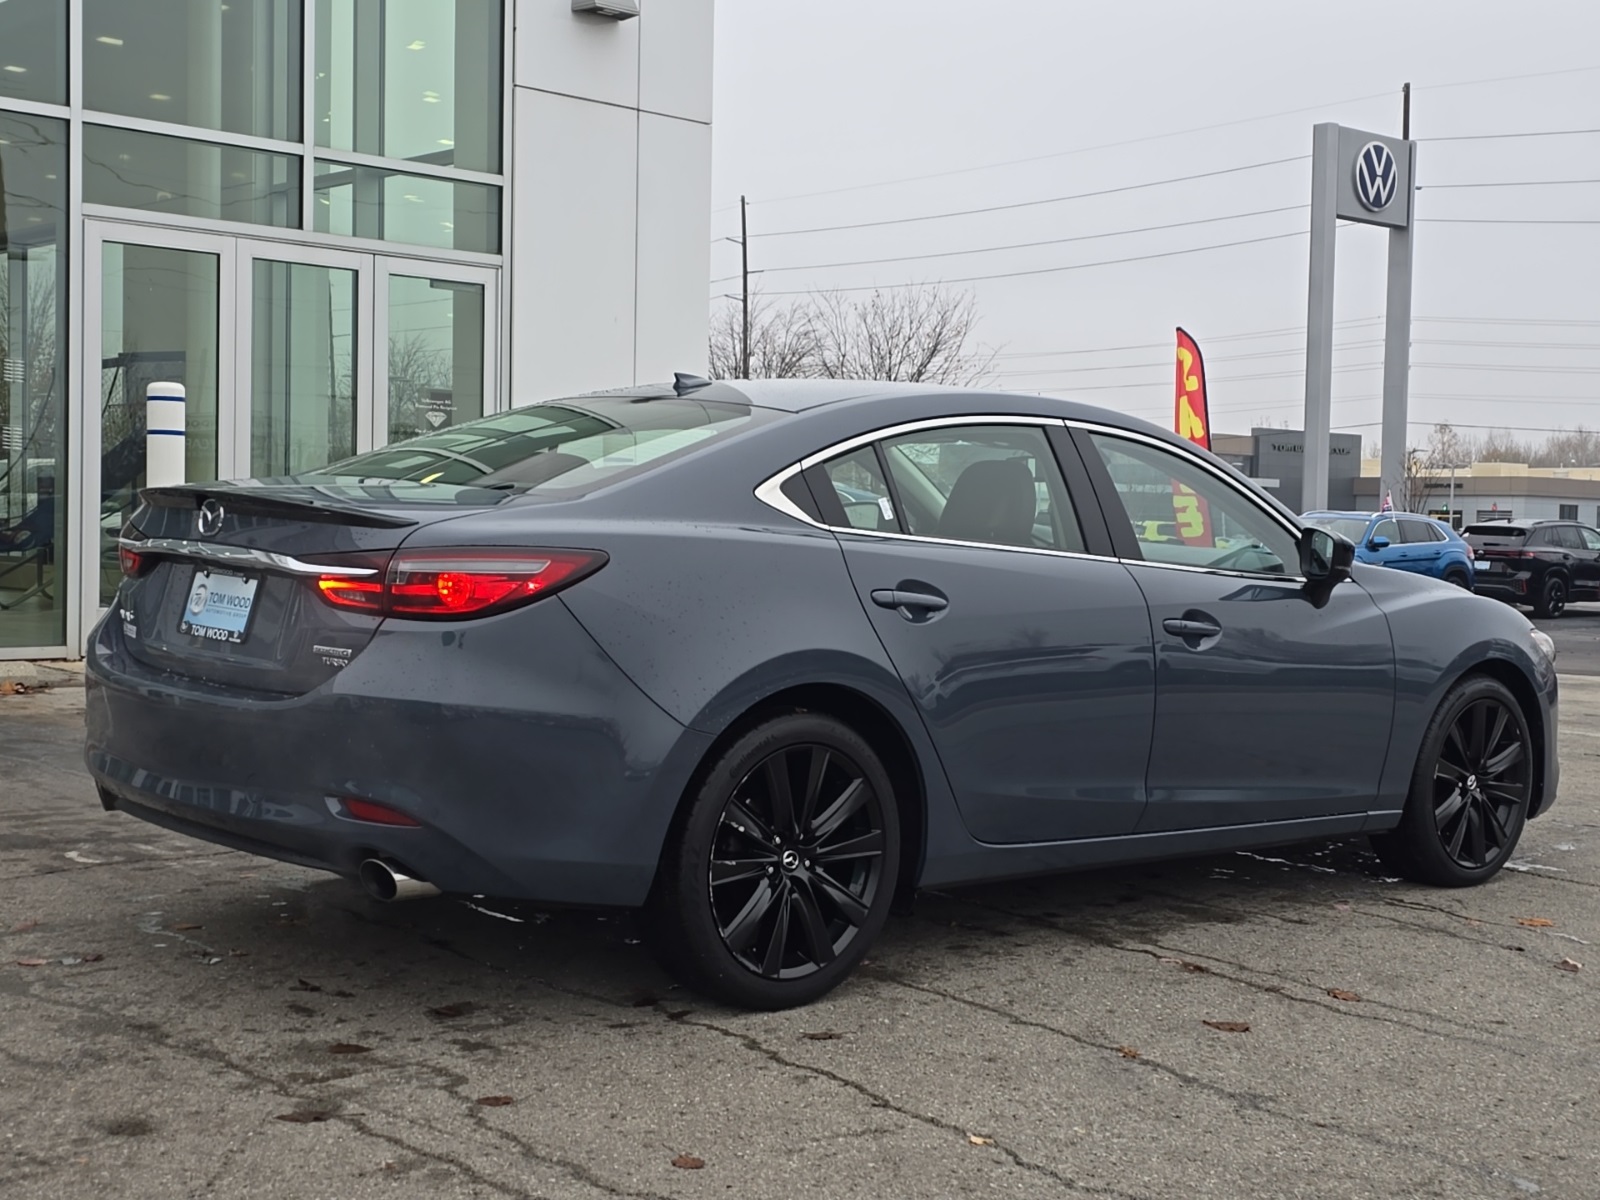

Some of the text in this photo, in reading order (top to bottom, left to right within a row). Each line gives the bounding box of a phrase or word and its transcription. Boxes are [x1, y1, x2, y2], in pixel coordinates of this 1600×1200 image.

[209, 592, 227, 605] TOM
[227, 595, 251, 609] WOOD
[191, 625, 207, 637] TOM
[206, 627, 228, 641] WOOD
